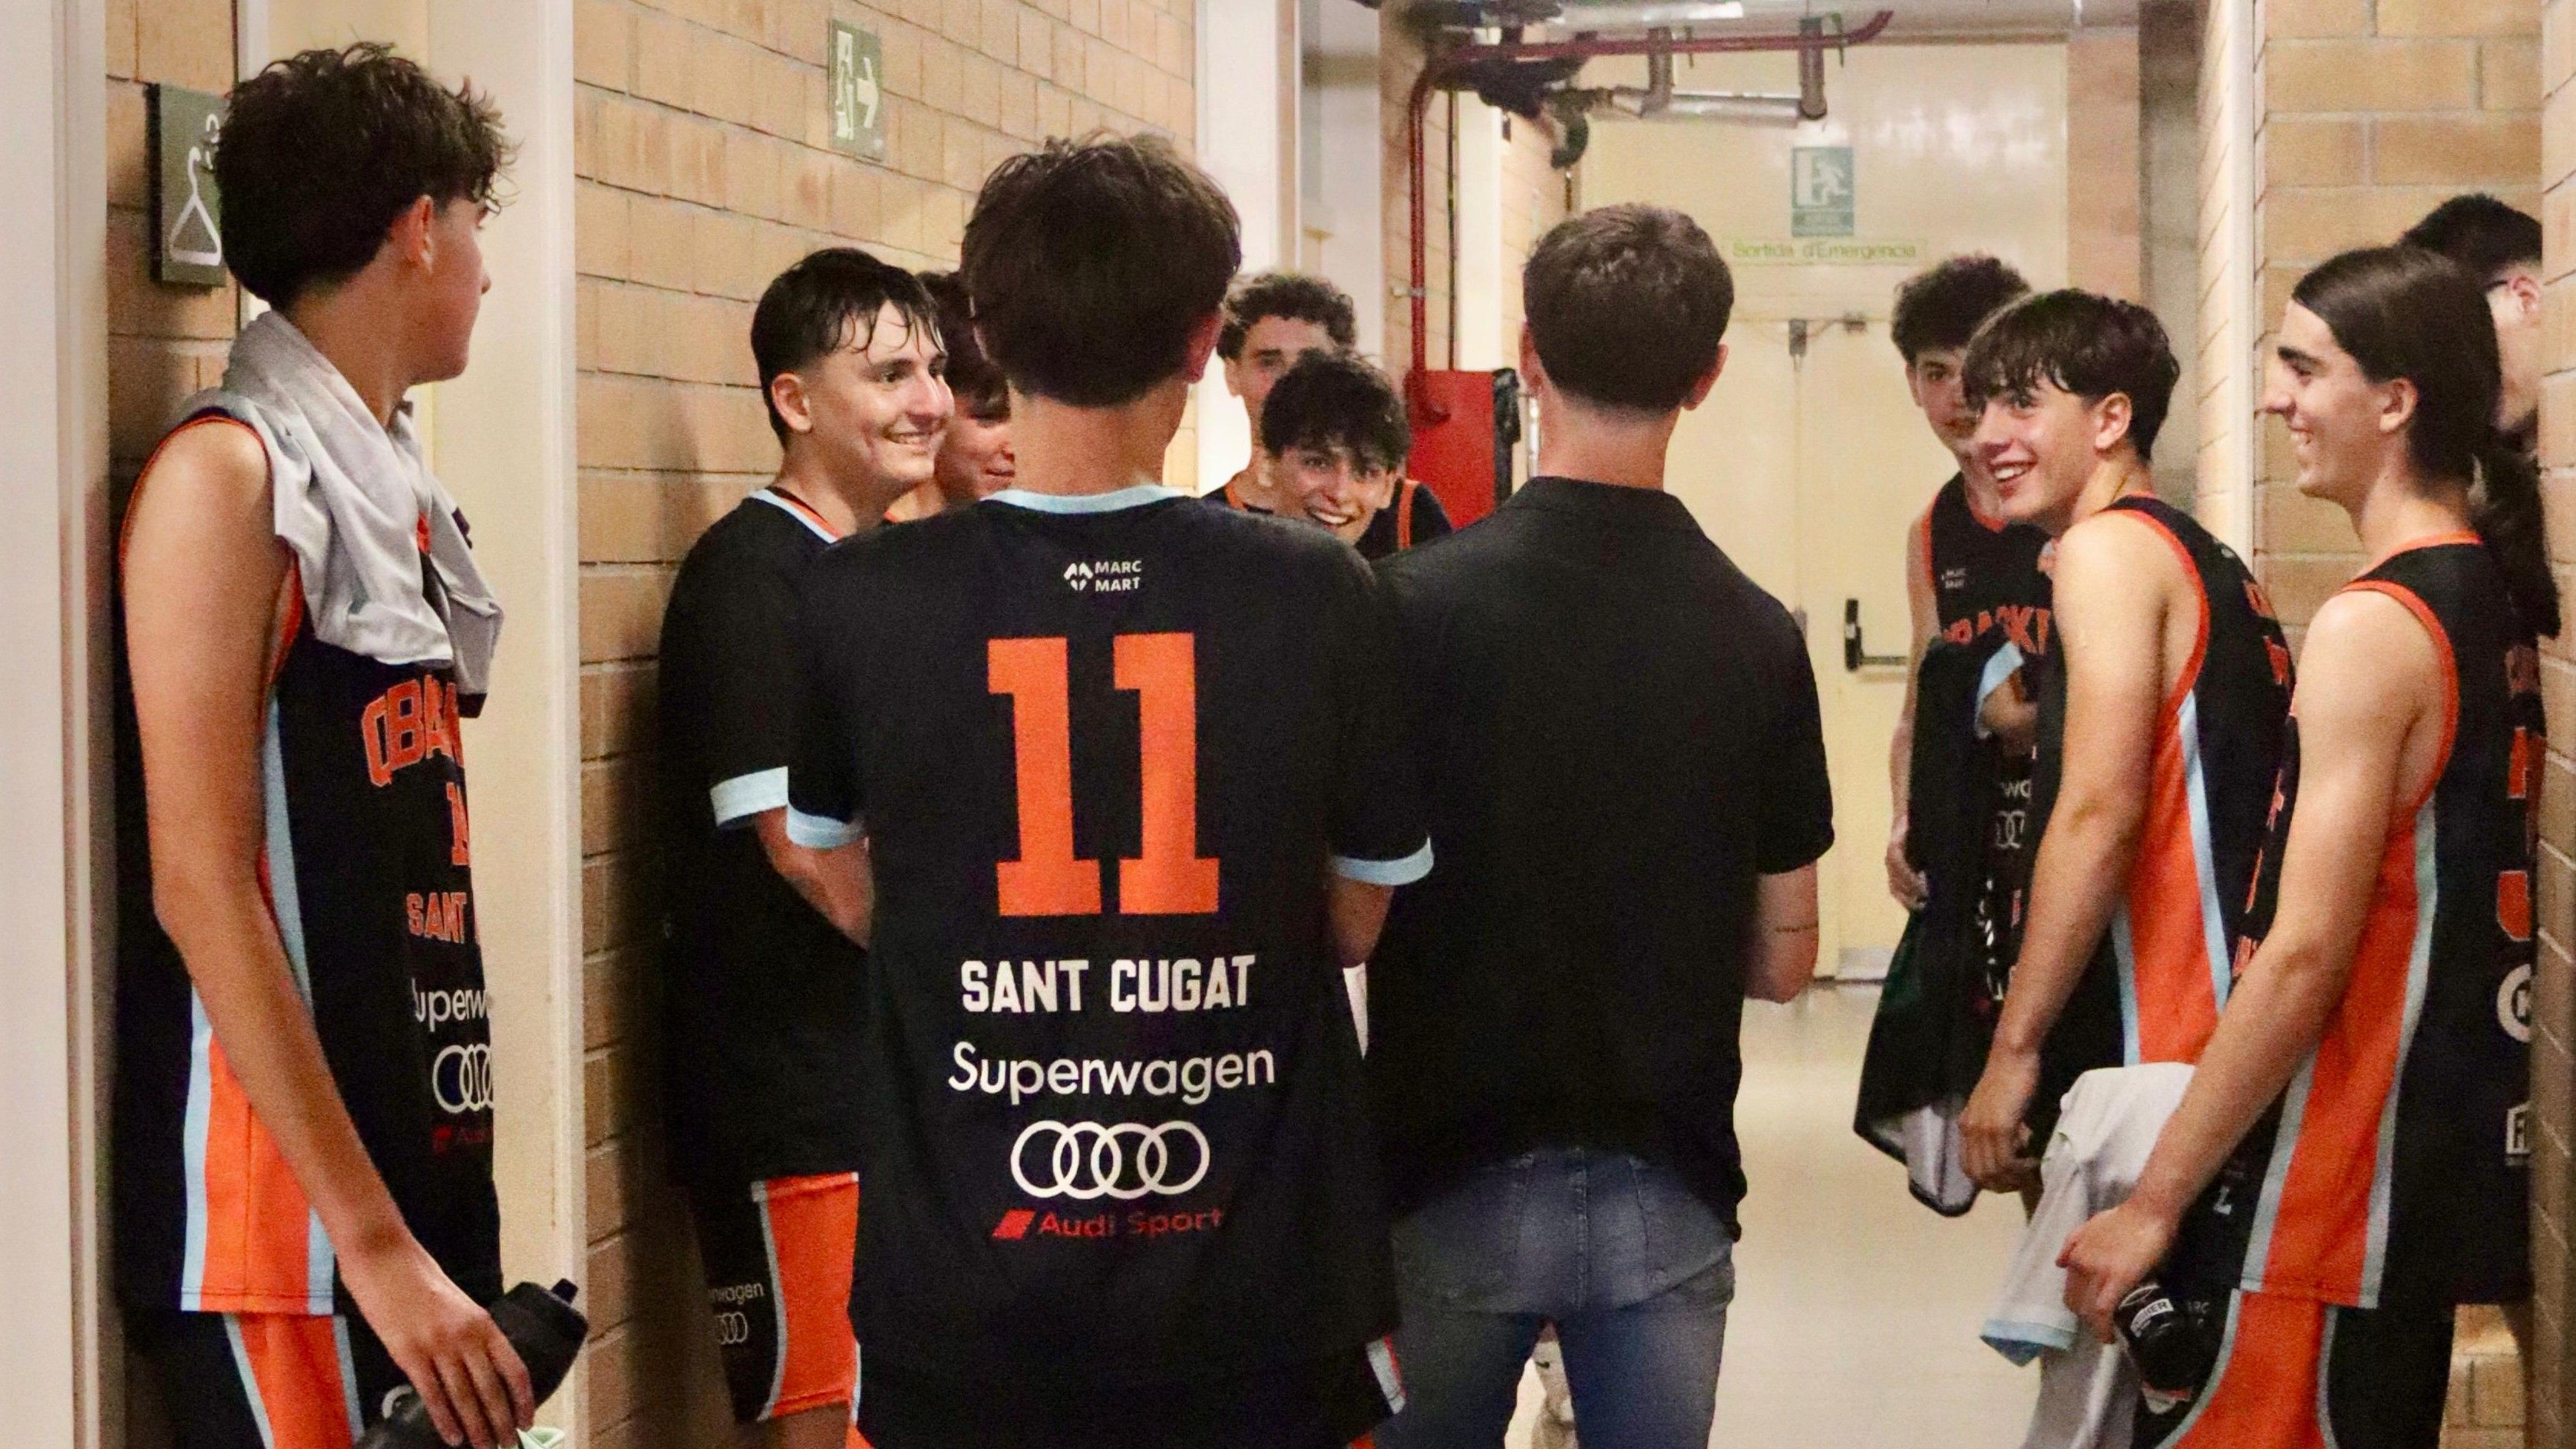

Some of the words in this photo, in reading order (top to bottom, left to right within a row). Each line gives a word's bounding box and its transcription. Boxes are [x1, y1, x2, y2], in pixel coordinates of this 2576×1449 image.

[1095, 559, 1141, 574] MARC
[1095, 576, 1141, 592] MART
[988, 632, 1220, 916] 11
[406, 892, 467, 944] SANT
[960, 959, 1089, 1013] SANT
[1110, 954, 1256, 1013] CUGAT
[948, 1041, 1276, 1105] Superwagen
[1039, 1210, 1115, 1238] Audi
[1127, 1207, 1225, 1238] Sport
